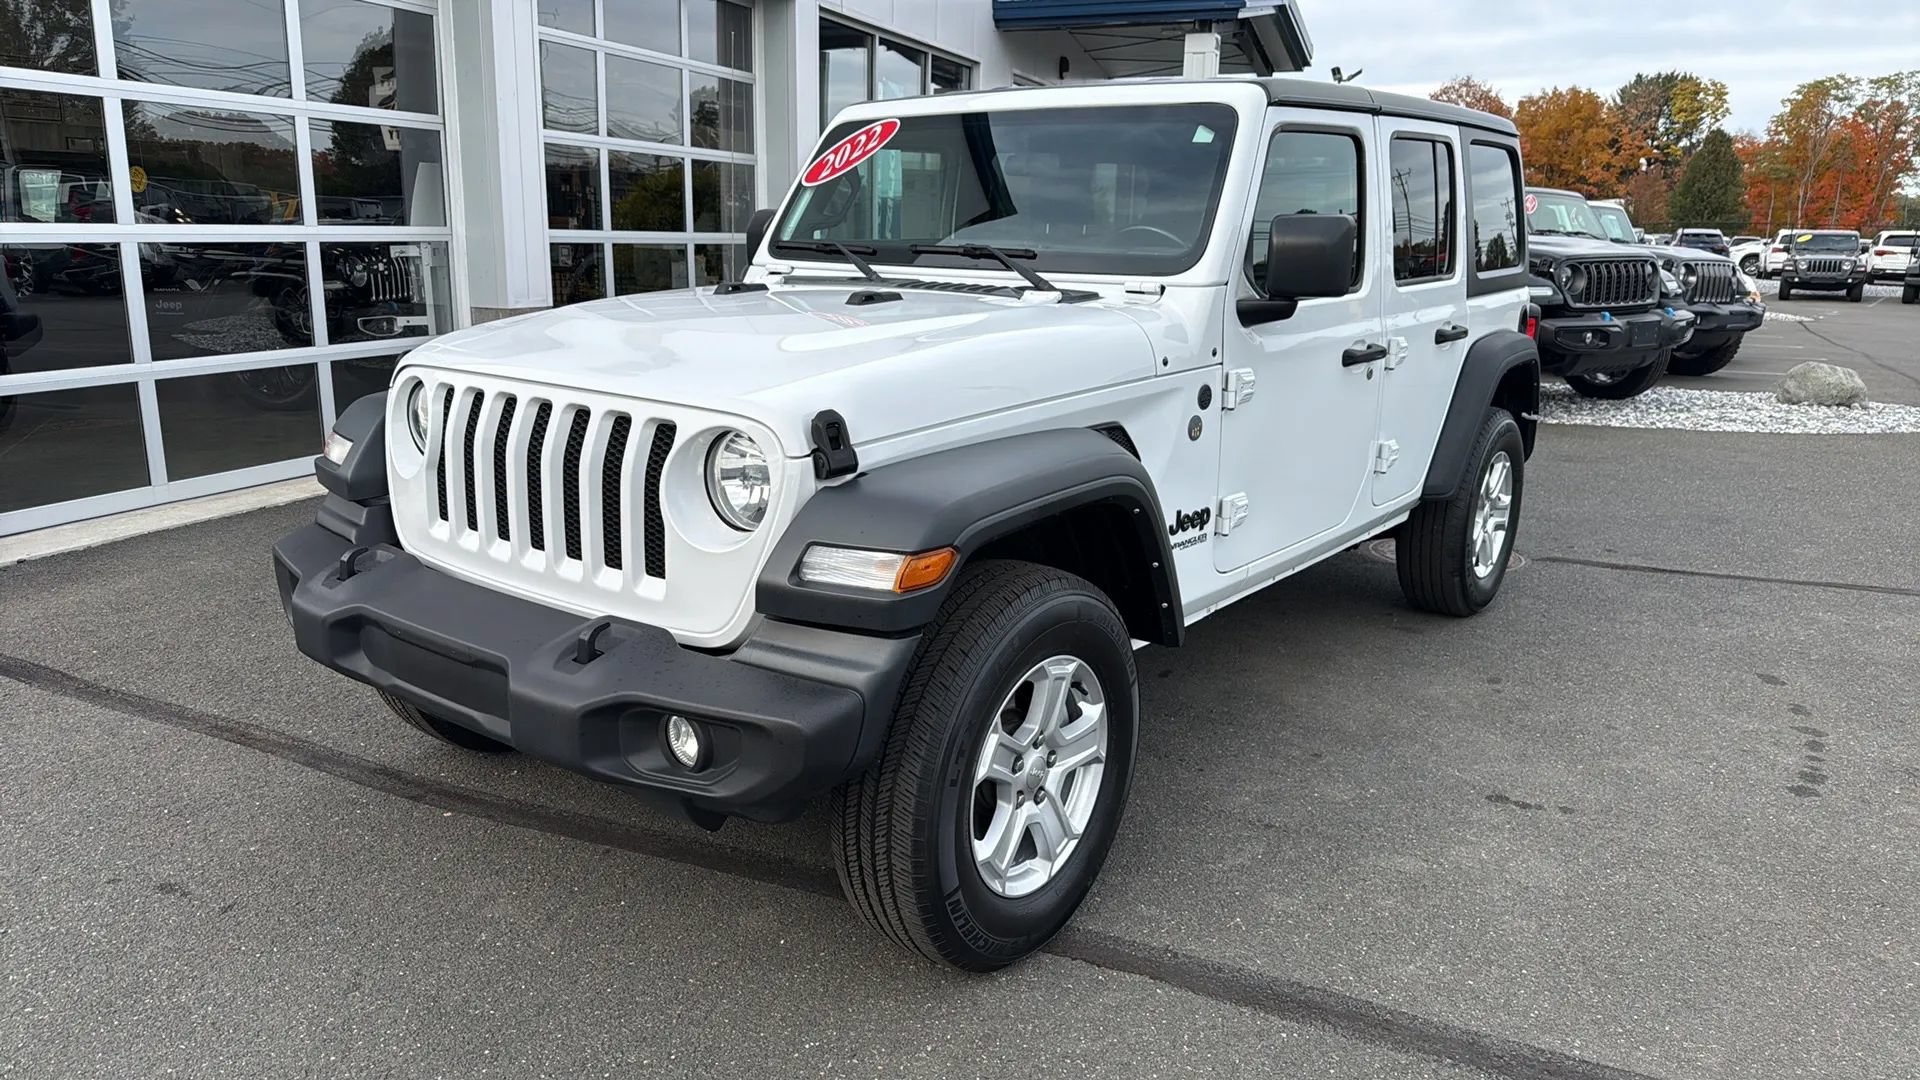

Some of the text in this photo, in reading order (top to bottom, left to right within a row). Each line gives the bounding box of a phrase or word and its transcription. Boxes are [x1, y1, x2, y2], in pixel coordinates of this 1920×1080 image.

[818, 124, 882, 180] 2022
[155, 300, 182, 310] Jeep
[1169, 507, 1211, 536] Jeep
[947, 897, 1005, 955] MICHELIN
